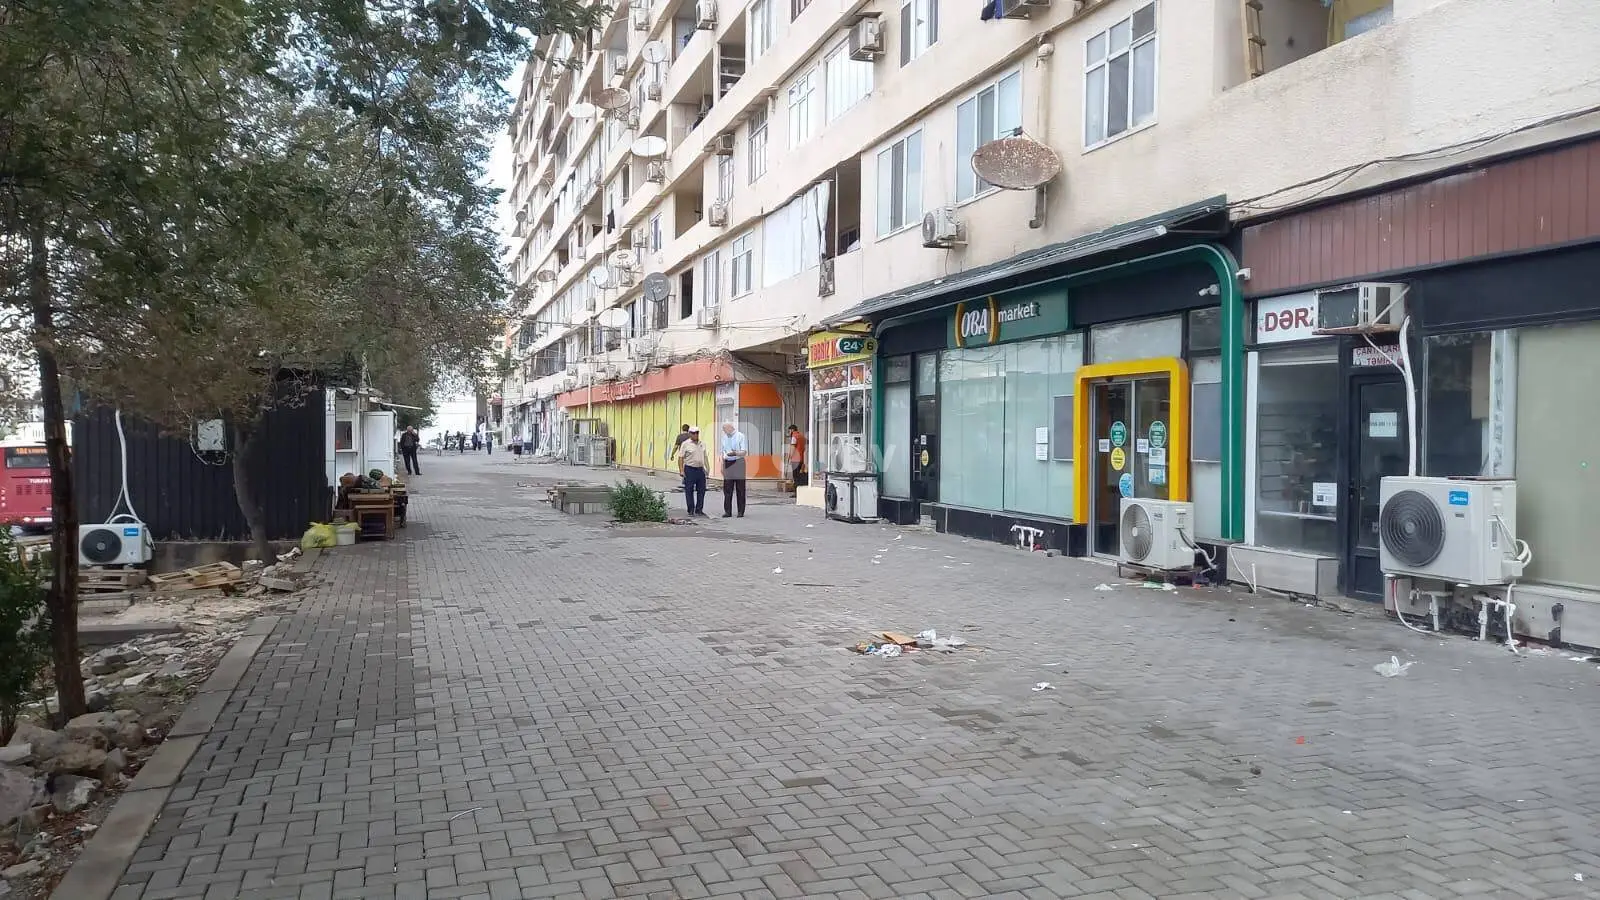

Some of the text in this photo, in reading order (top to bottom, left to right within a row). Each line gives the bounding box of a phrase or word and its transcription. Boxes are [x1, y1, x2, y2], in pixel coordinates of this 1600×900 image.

[961, 302, 1036, 337] OBA market
[843, 341, 858, 351] 24
